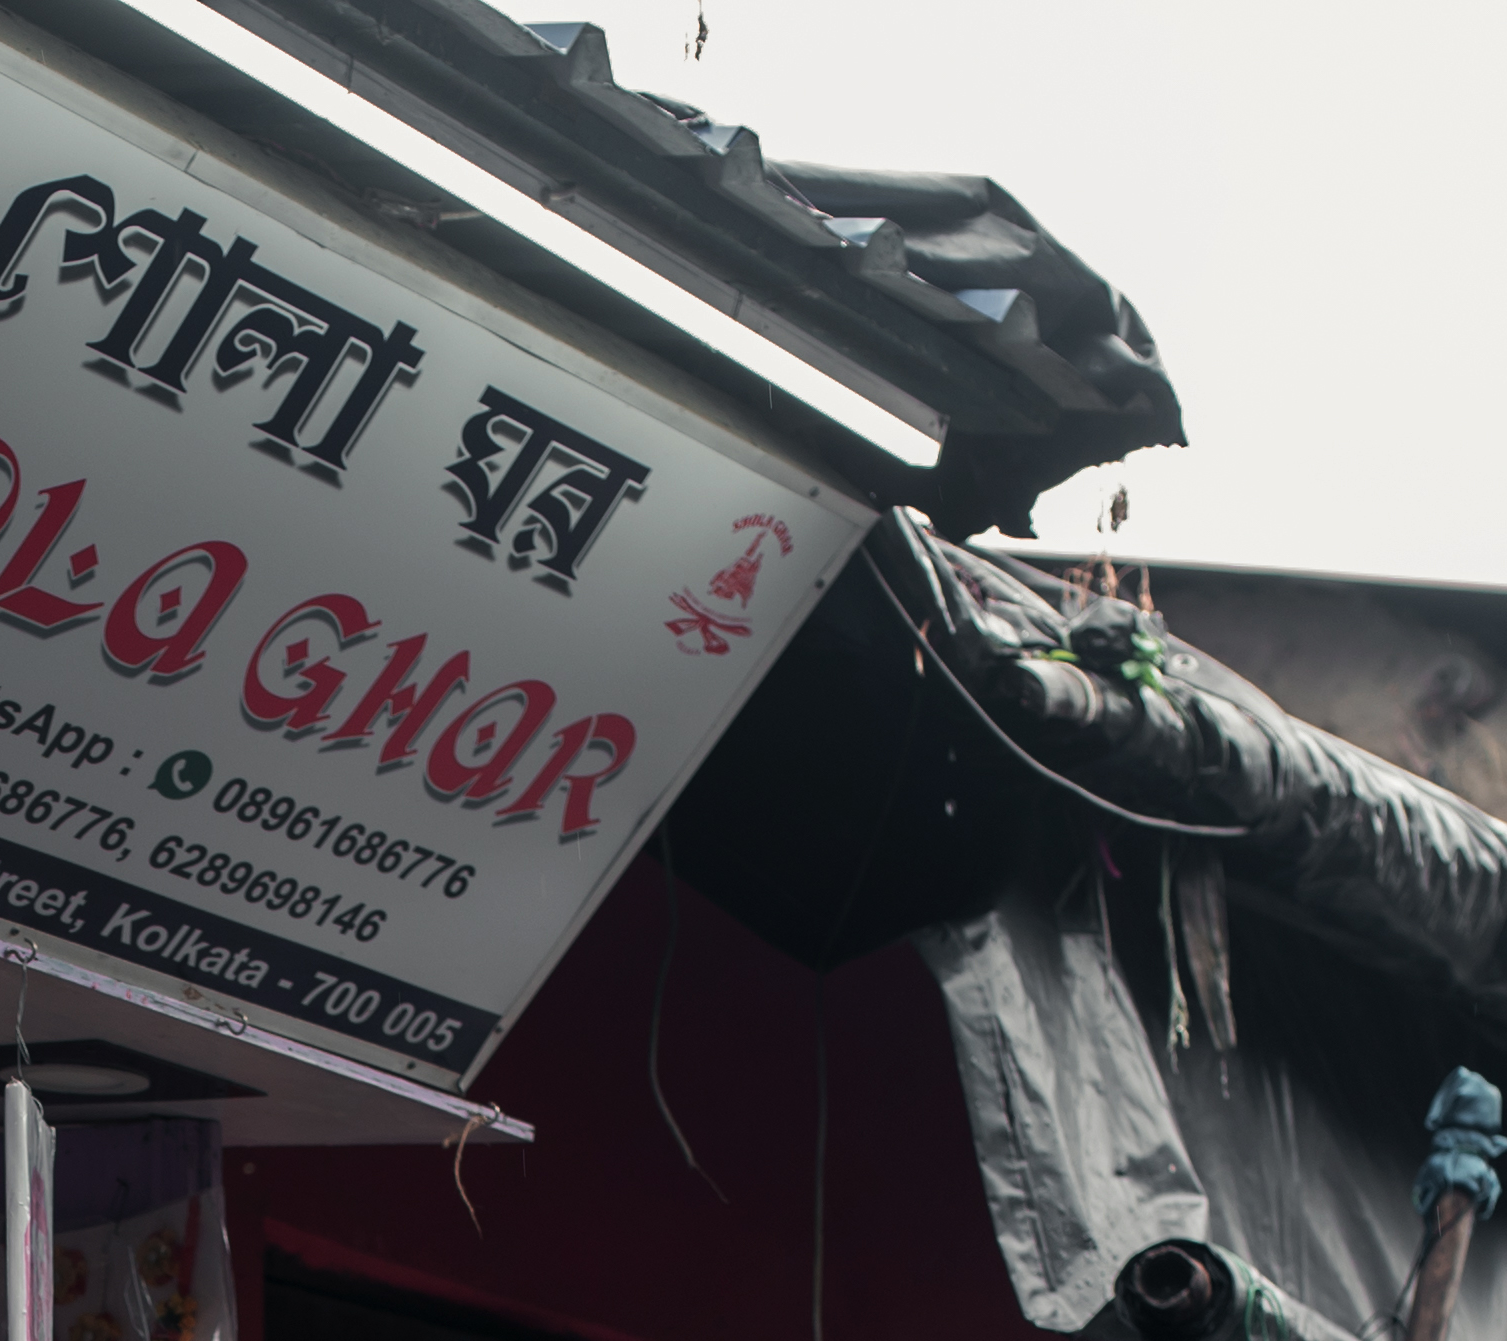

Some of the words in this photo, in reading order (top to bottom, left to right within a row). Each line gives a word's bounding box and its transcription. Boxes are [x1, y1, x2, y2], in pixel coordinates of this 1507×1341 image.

[442, 384, 653, 584] ঘর
[147, 834, 388, 943] 6289698146
[212, 777, 476, 899] 08961686776
[100, 902, 271, 992] Kolkata
[300, 970, 382, 1025] 700
[382, 1001, 463, 1053] 005
